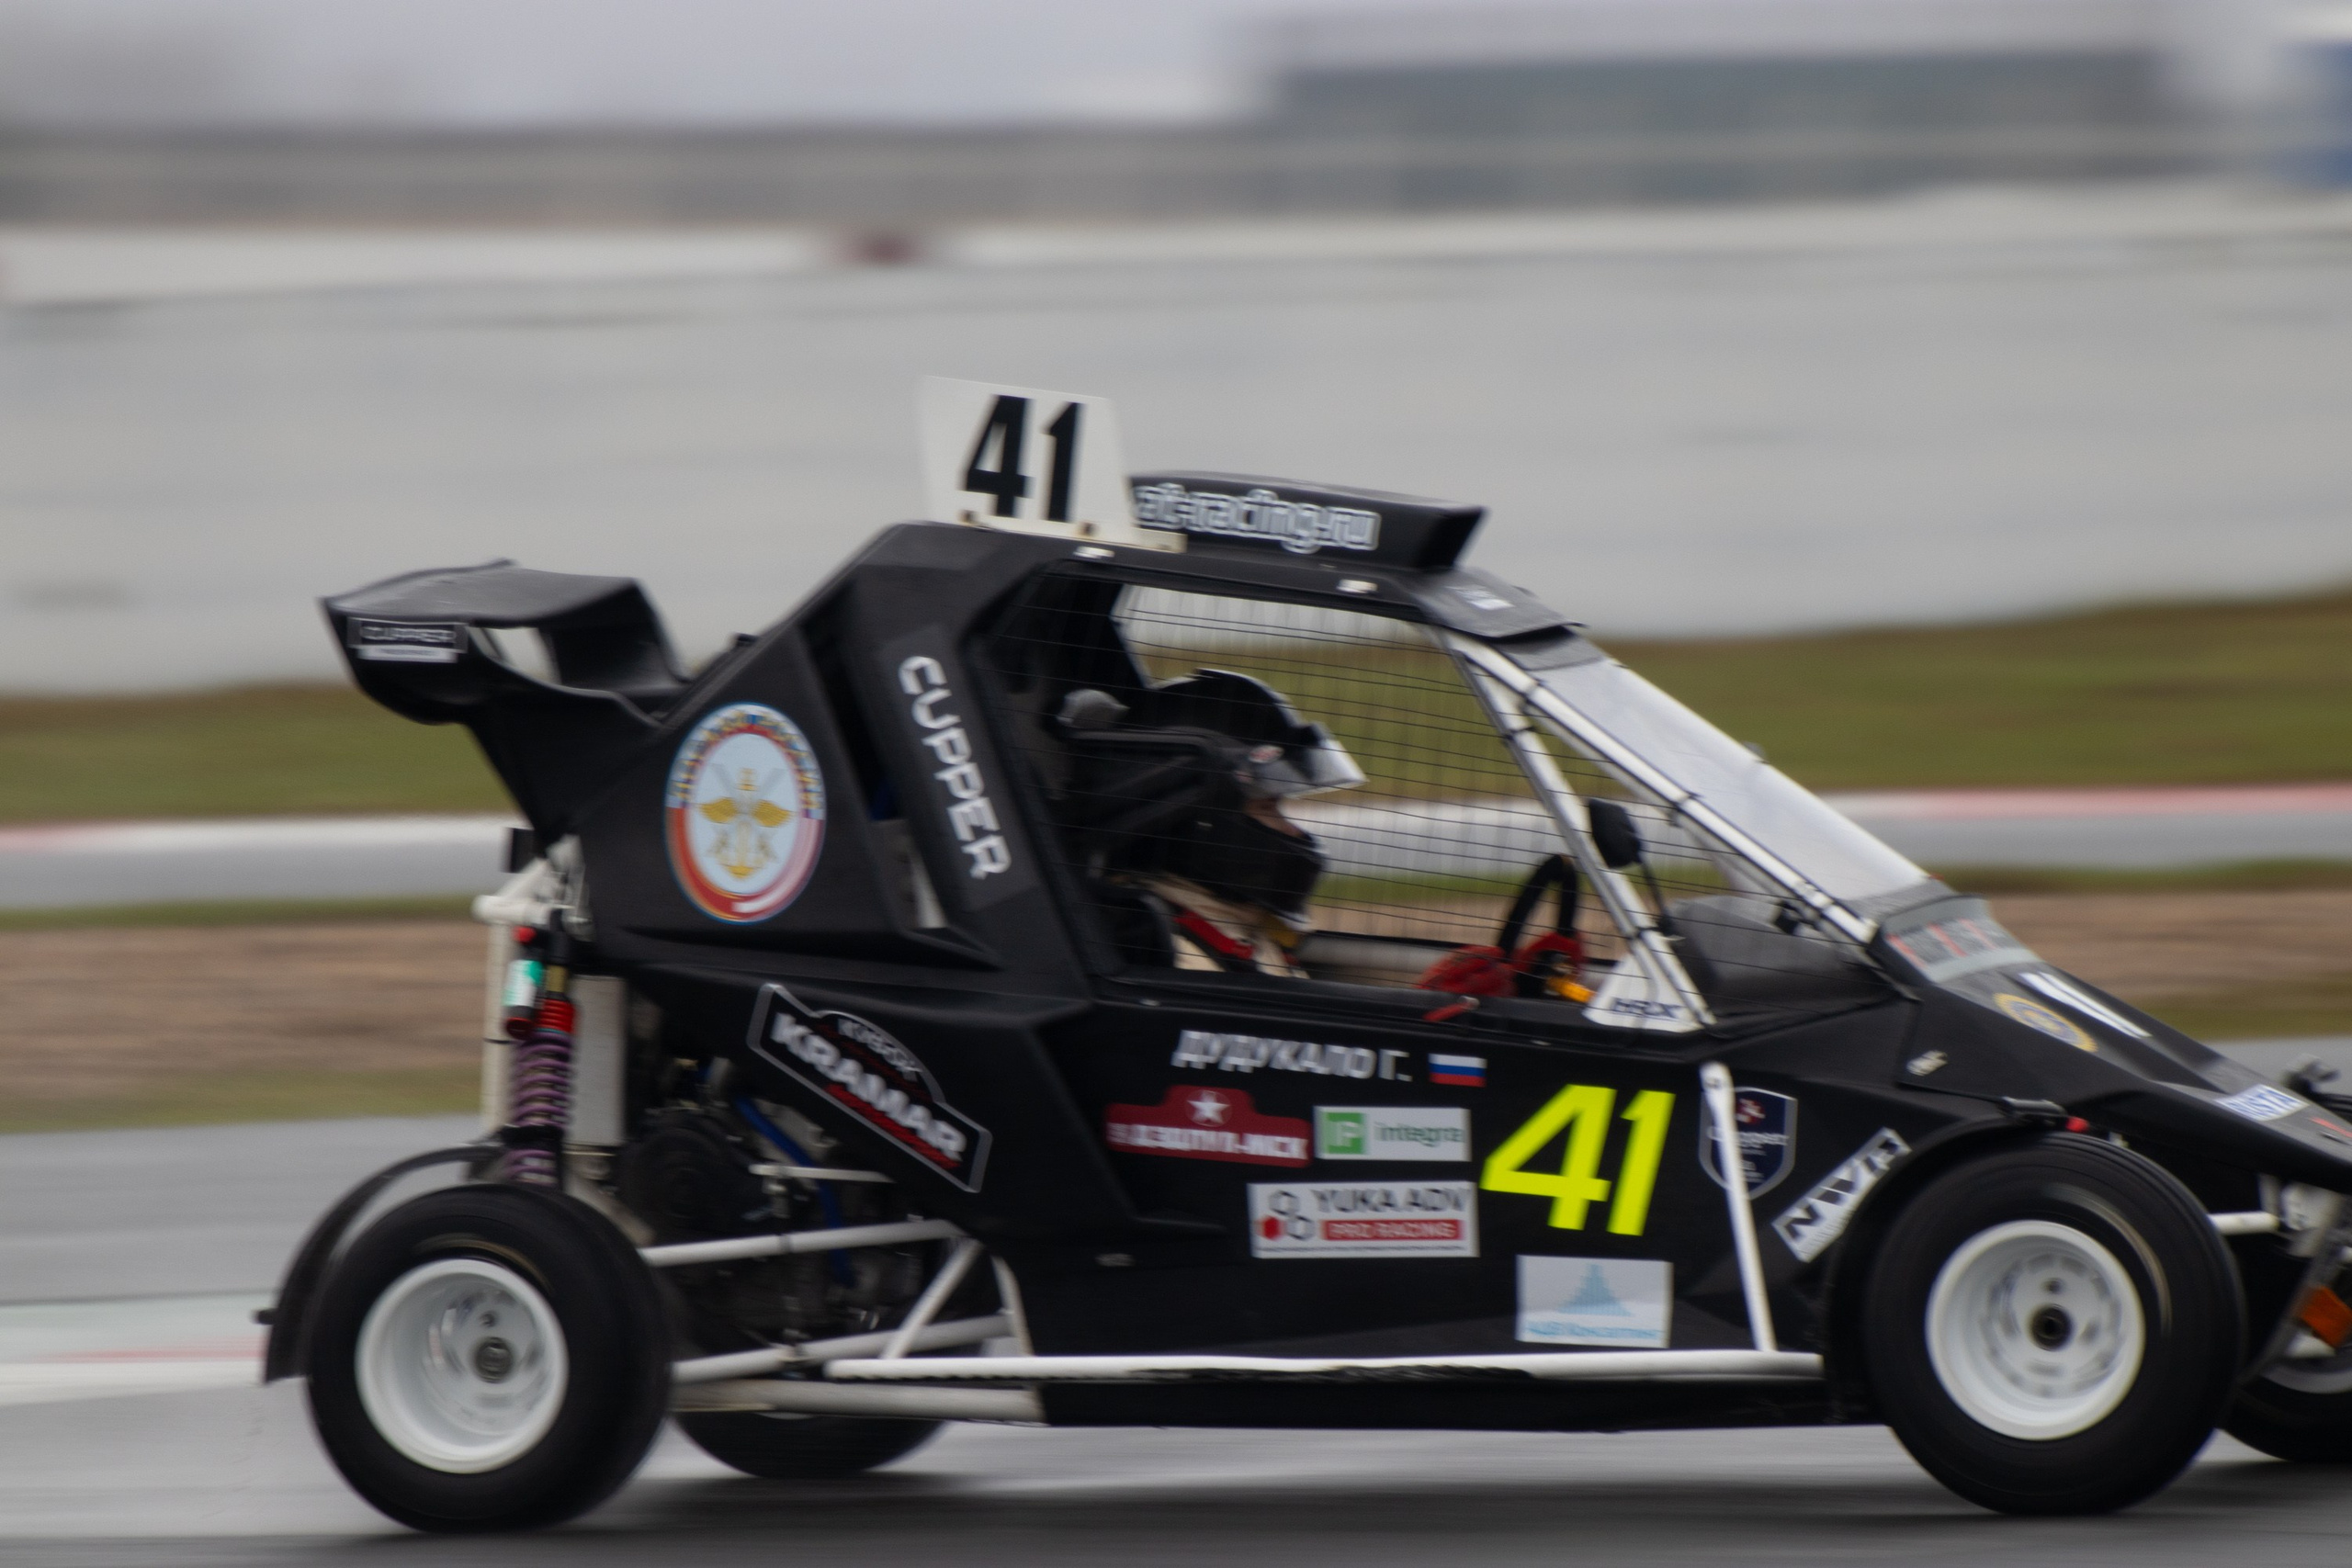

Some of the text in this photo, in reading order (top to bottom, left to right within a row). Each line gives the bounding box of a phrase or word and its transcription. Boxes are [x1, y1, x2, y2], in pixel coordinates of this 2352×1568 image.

[962, 394, 1087, 523] 41
[899, 656, 1012, 880] CUPPER
[770, 1012, 967, 1162] KRAMAR
[1170, 1029, 1413, 1082] ДУДУКАЛО Г.
[1375, 1122, 1466, 1147] integra
[1479, 1083, 1676, 1235] 41
[1311, 1189, 1399, 1213] YUKA
